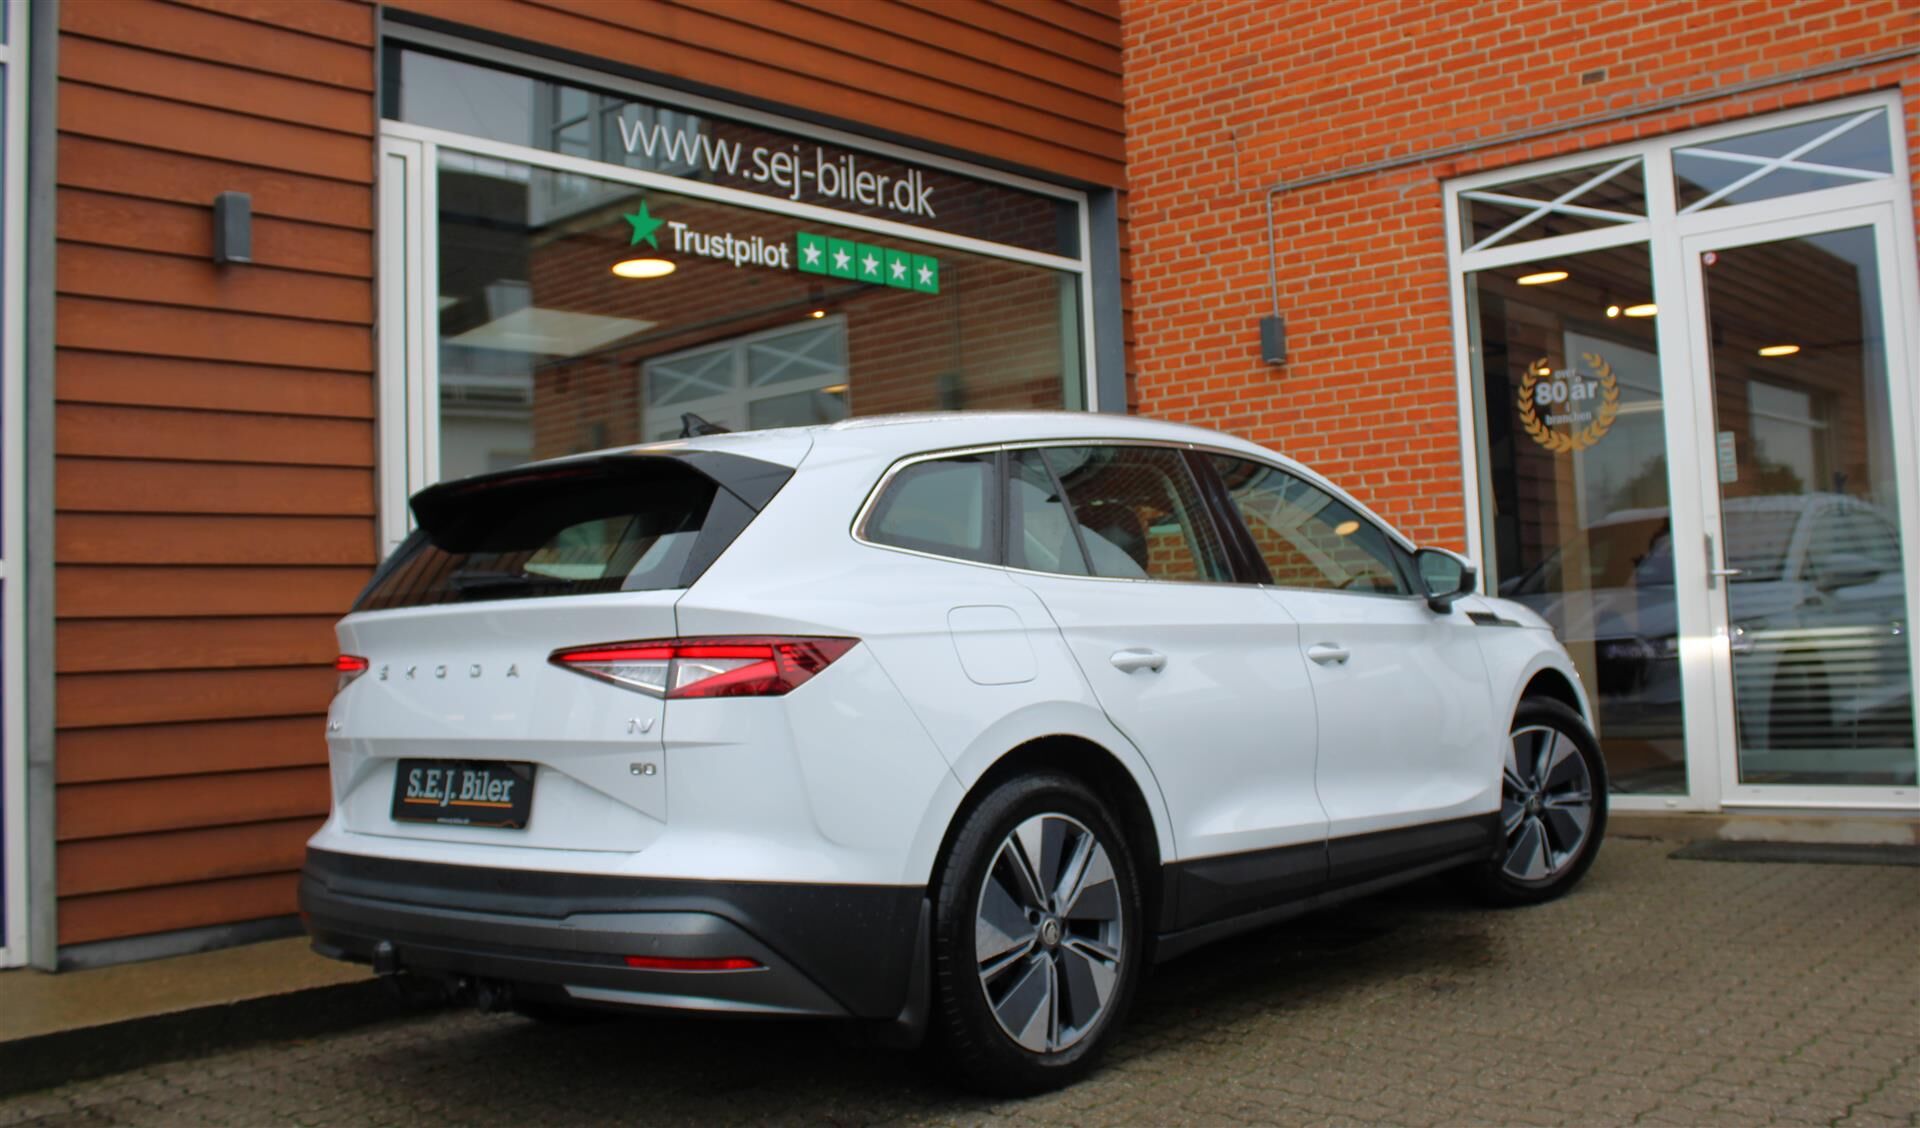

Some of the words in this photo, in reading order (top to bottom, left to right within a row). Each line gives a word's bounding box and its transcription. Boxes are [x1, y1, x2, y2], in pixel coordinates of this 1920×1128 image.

[618, 116, 936, 218] www.sej-biler.dk
[668, 221, 790, 269] Trustpilot
[1535, 380, 1568, 406] 80
[1570, 376, 1598, 400] år
[406, 768, 457, 807] S.E.J.
[459, 769, 514, 802] Biler
